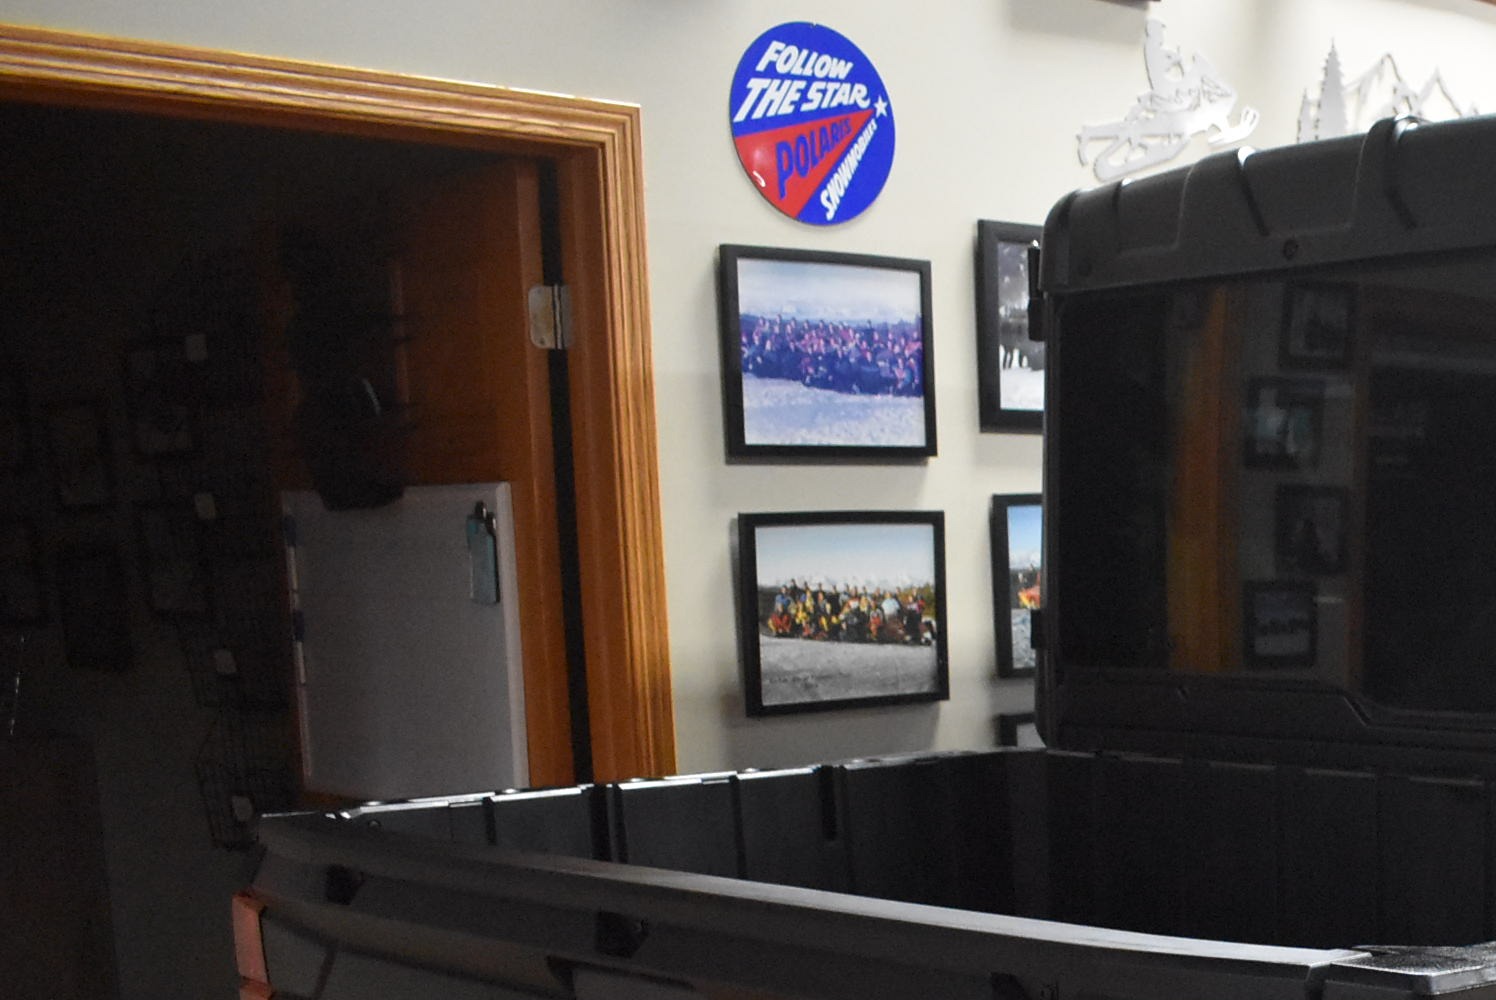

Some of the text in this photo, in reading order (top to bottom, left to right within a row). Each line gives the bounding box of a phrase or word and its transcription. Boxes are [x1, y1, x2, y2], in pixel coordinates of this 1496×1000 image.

[755, 40, 854, 80] FOLLOW
[733, 77, 871, 123] THE STAR
[775, 118, 853, 200] POLARIS
[820, 118, 878, 221] SNOWMOBILES
